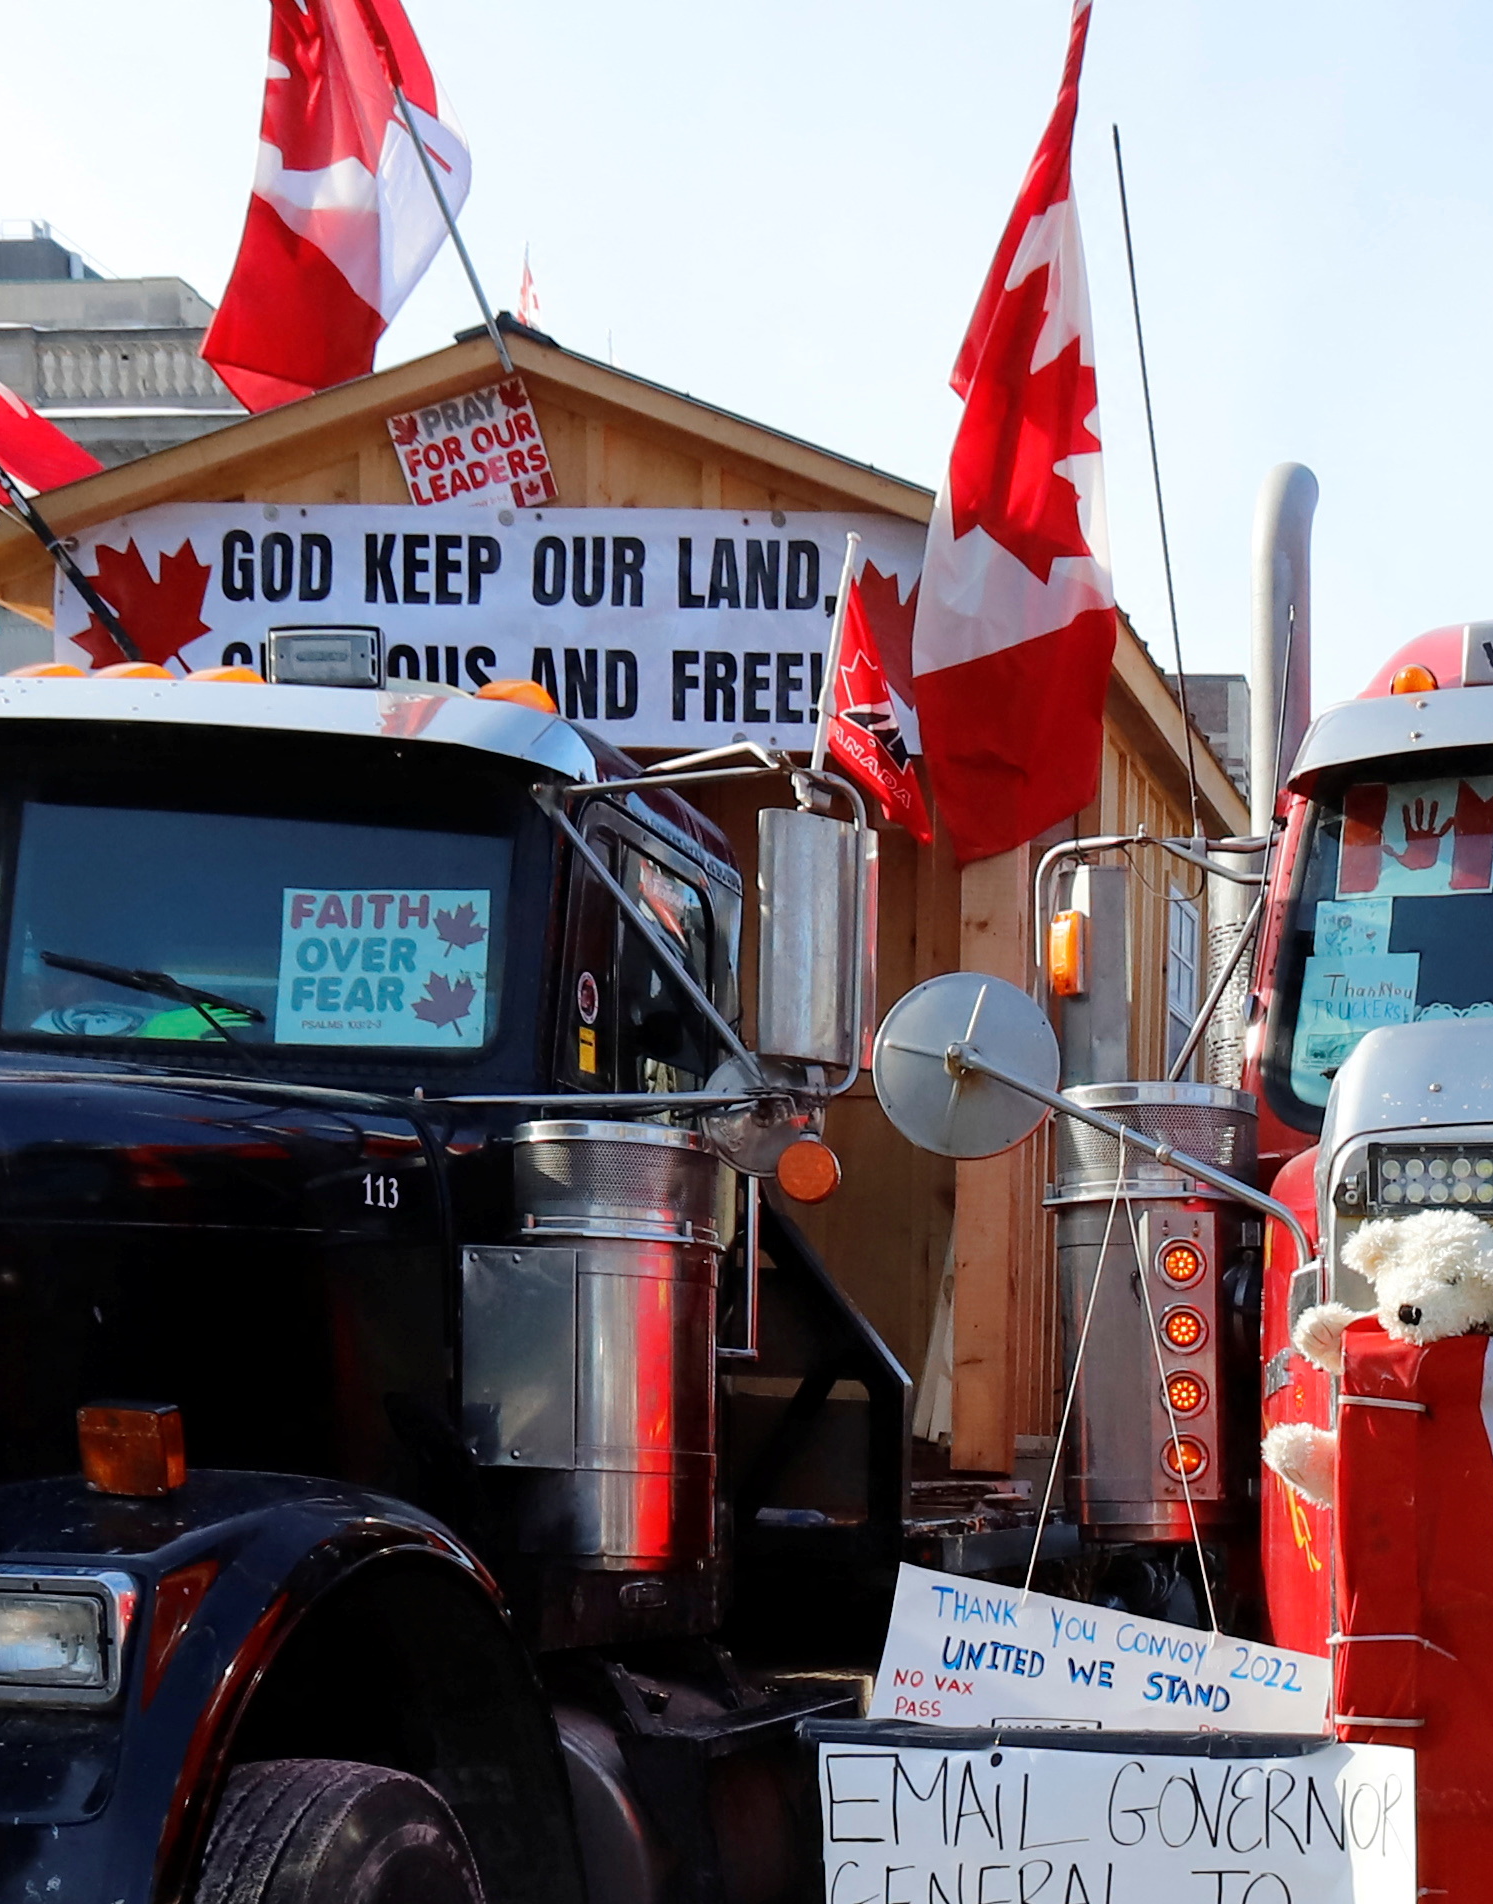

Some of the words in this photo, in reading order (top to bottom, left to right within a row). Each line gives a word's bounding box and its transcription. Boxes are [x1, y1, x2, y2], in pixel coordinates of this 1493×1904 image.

[419, 387, 497, 439] PRAY
[405, 436, 465, 477] FOR
[471, 412, 536, 454] OUR
[411, 444, 547, 506] LEADERS
[221, 529, 333, 602] GOD
[365, 533, 501, 606] KEEP
[532, 536, 645, 608] OUR
[677, 537, 838, 618] LAND,
[532, 648, 638, 720] AND
[672, 651, 823, 724] FREE!
[291, 894, 430, 929] FAITH
[296, 937, 417, 973] OVER
[291, 977, 404, 1012] FEAR
[302, 1020, 342, 1029] PSALMS
[362, 1172, 399, 1208] 113
[931, 1585, 1018, 1629] THANK
[1116, 1622, 1208, 1676] CONVOY
[1230, 1646, 1302, 1693] 2022
[893, 1668, 924, 1689] NO
[934, 1676, 975, 1696] VAX
[942, 1636, 1045, 1678] UNITED
[1068, 1657, 1116, 1689] WE
[1143, 1671, 1231, 1712] STAND
[894, 1696, 942, 1717] PASS
[1108, 1761, 1404, 1857] GOVERNOR
